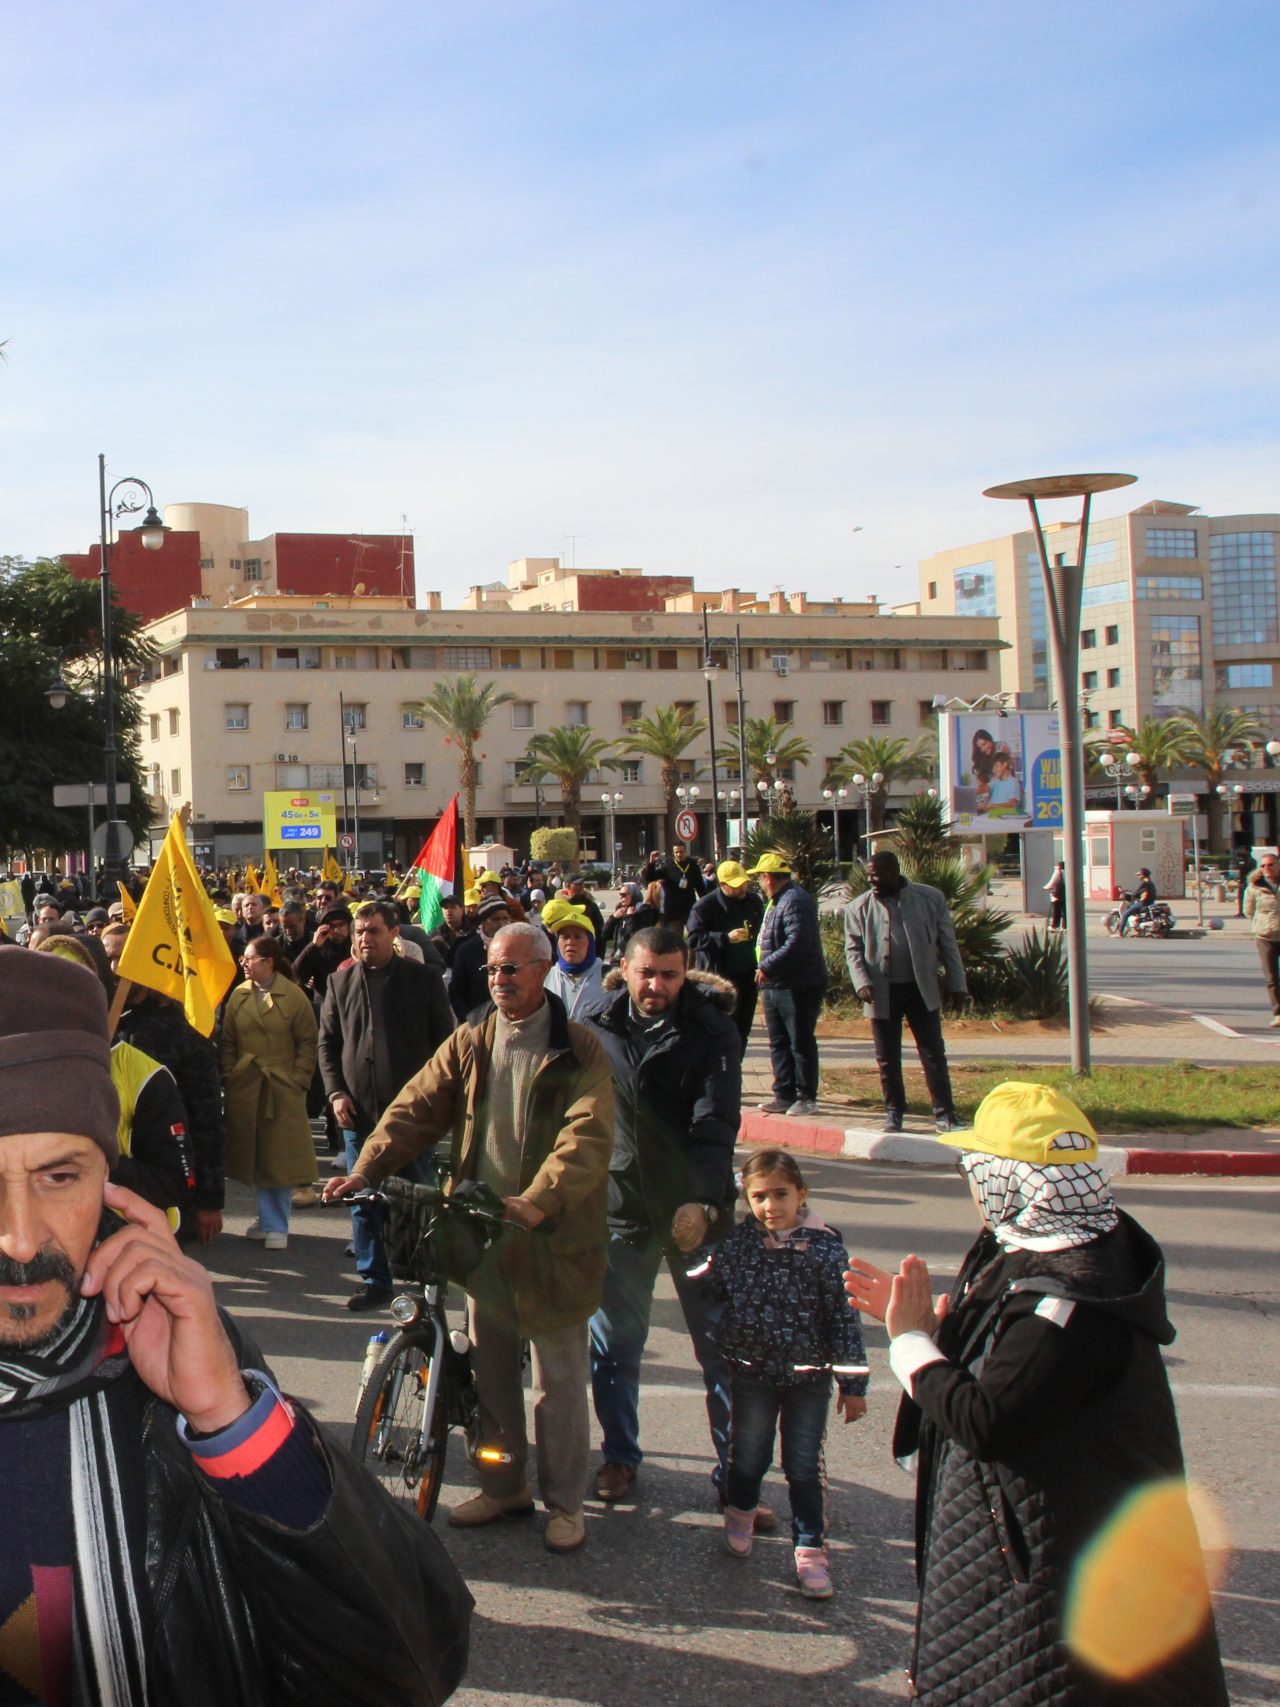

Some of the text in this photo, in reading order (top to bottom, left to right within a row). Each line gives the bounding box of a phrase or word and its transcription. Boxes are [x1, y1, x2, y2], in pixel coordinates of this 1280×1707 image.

[1040, 773, 1062, 789] FIBR
[1037, 801, 1063, 820] 20
[300, 827, 319, 837] 249
